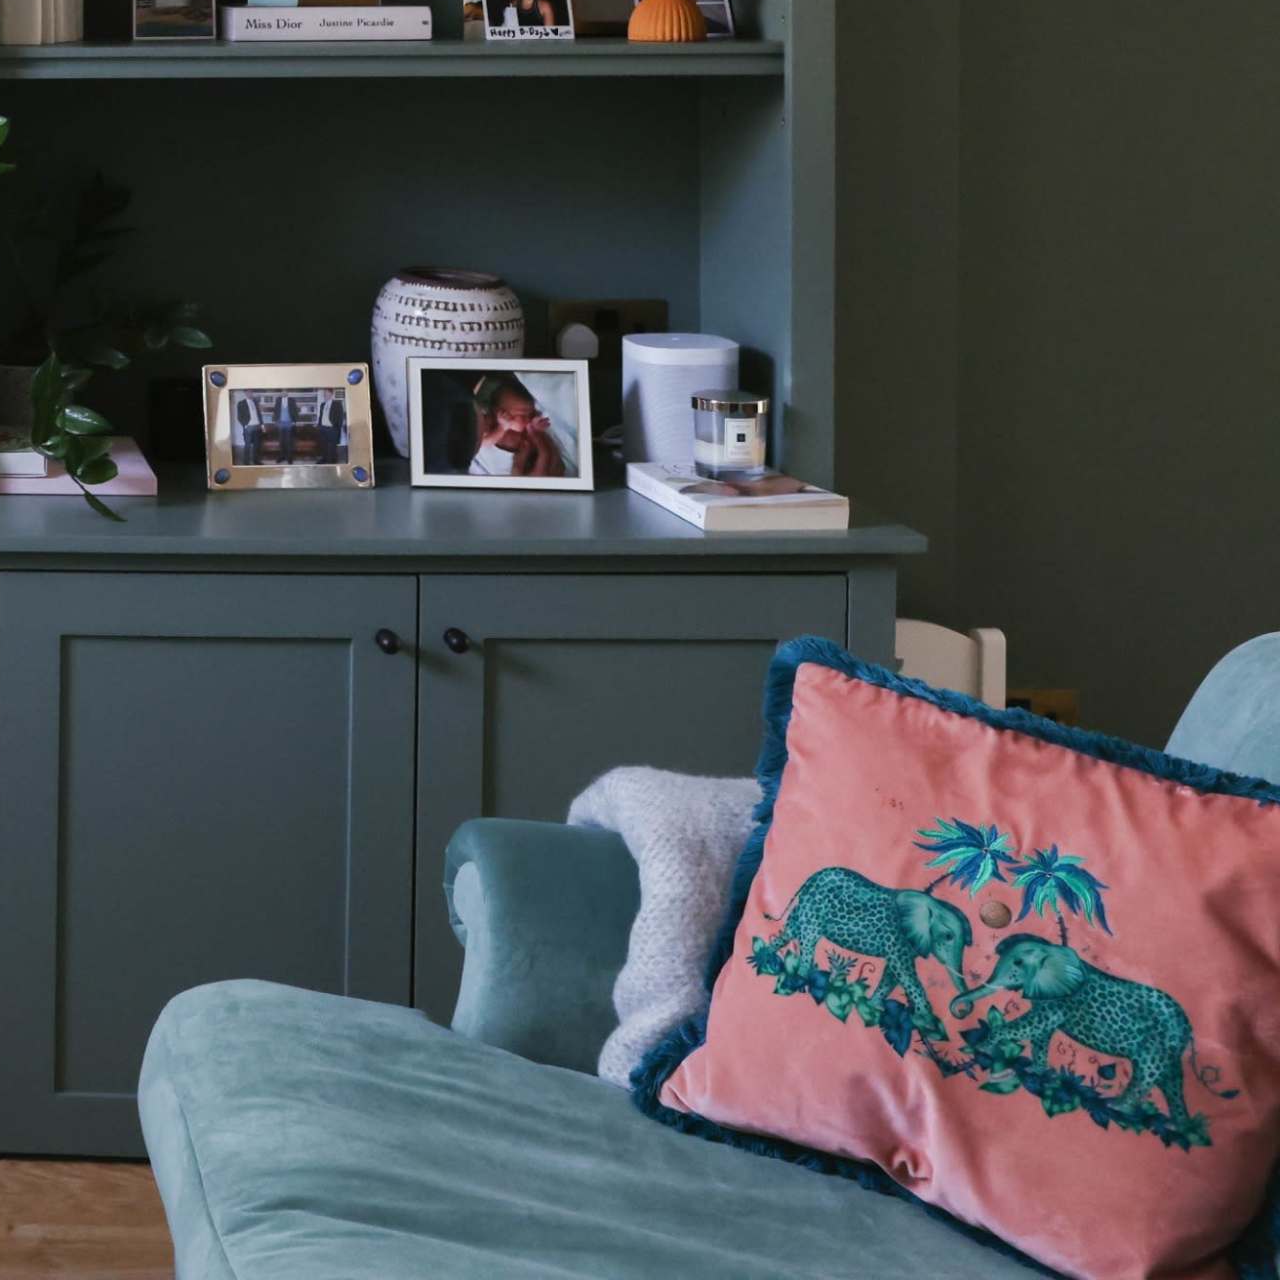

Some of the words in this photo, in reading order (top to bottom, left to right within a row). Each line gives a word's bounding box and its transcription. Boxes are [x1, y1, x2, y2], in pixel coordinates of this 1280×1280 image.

[245, 18, 273, 30] Miss
[276, 18, 304, 30] Dior
[319, 18, 353, 28] Justine
[356, 17, 395, 28] Picardie
